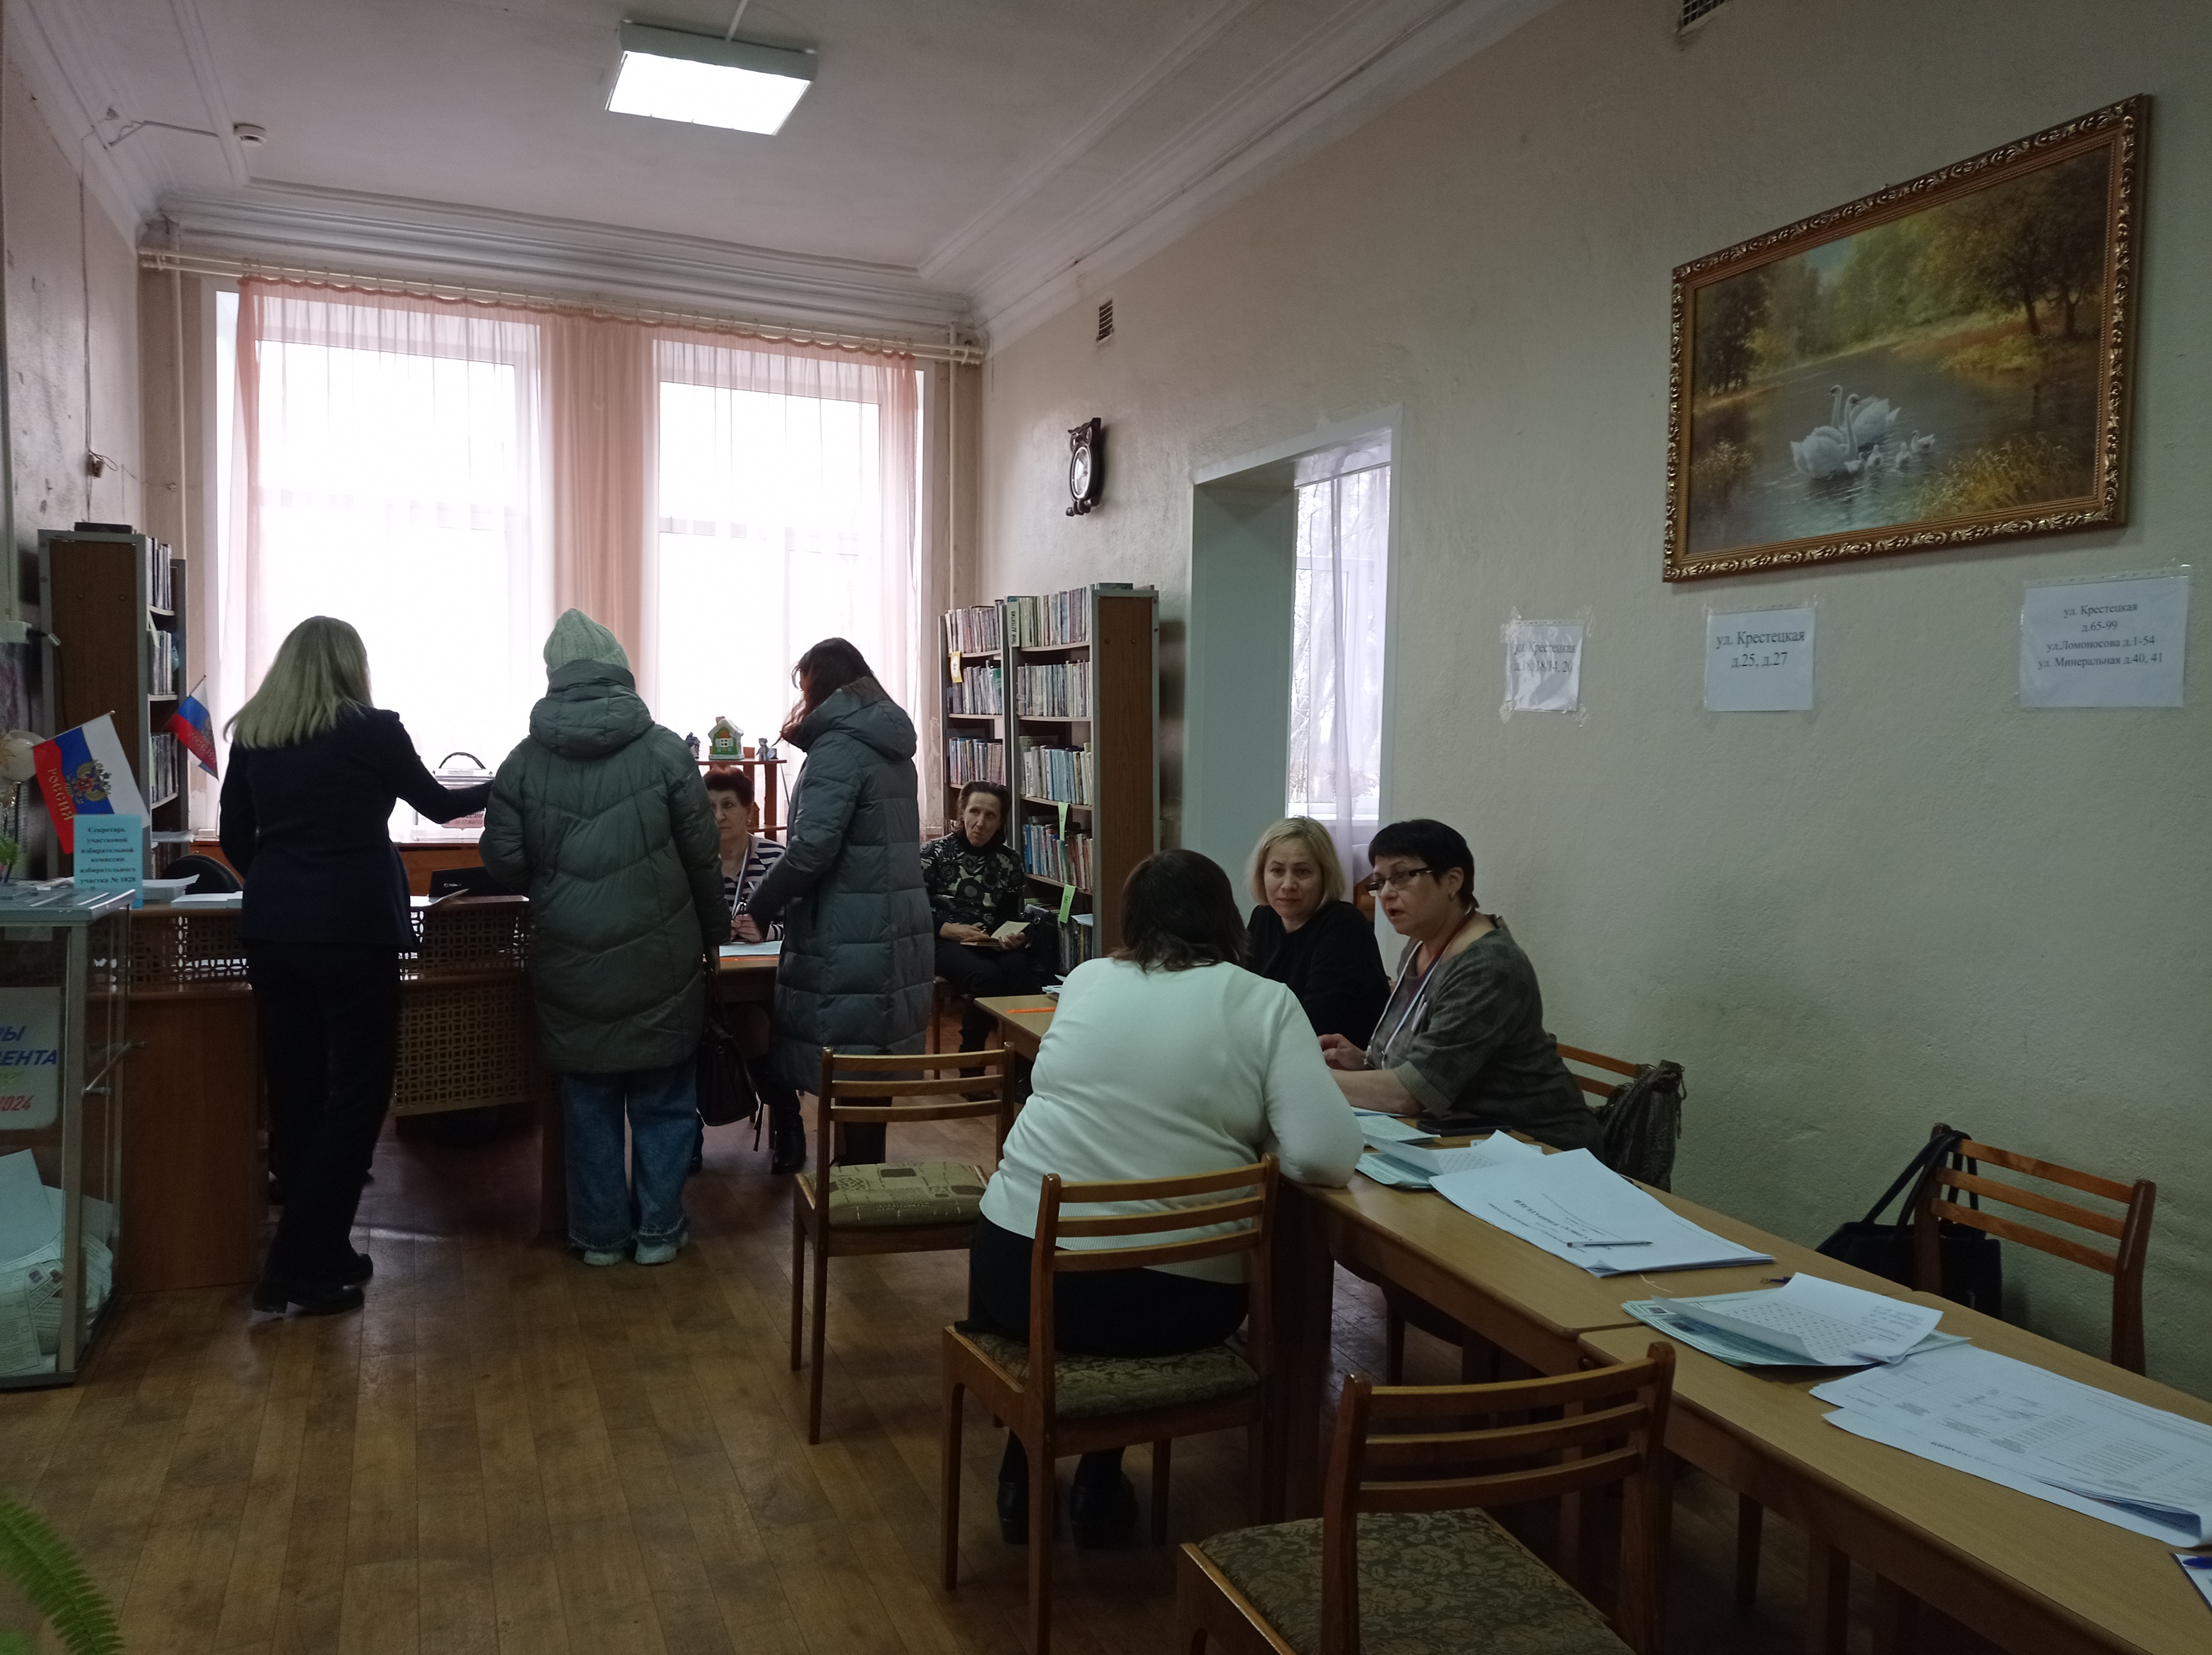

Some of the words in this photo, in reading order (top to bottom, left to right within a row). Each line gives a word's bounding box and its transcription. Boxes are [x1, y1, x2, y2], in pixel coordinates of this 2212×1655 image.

[2064, 609, 2077, 618] ул.
[2081, 604, 2137, 616] Крестецкая
[2081, 620, 2118, 632] д.65-99
[1716, 636, 1733, 649] ул.
[1736, 631, 1805, 648] Крестецкая
[1731, 653, 1759, 668] д.25,
[1762, 652, 1787, 667] д.27
[2038, 661, 2052, 670] ул.
[2055, 657, 2120, 668] Минеральная
[2151, 653, 2162, 662] 41
[48, 768, 74, 820] РОССИЯ
[0, 1049, 58, 1066] ЕНТА
